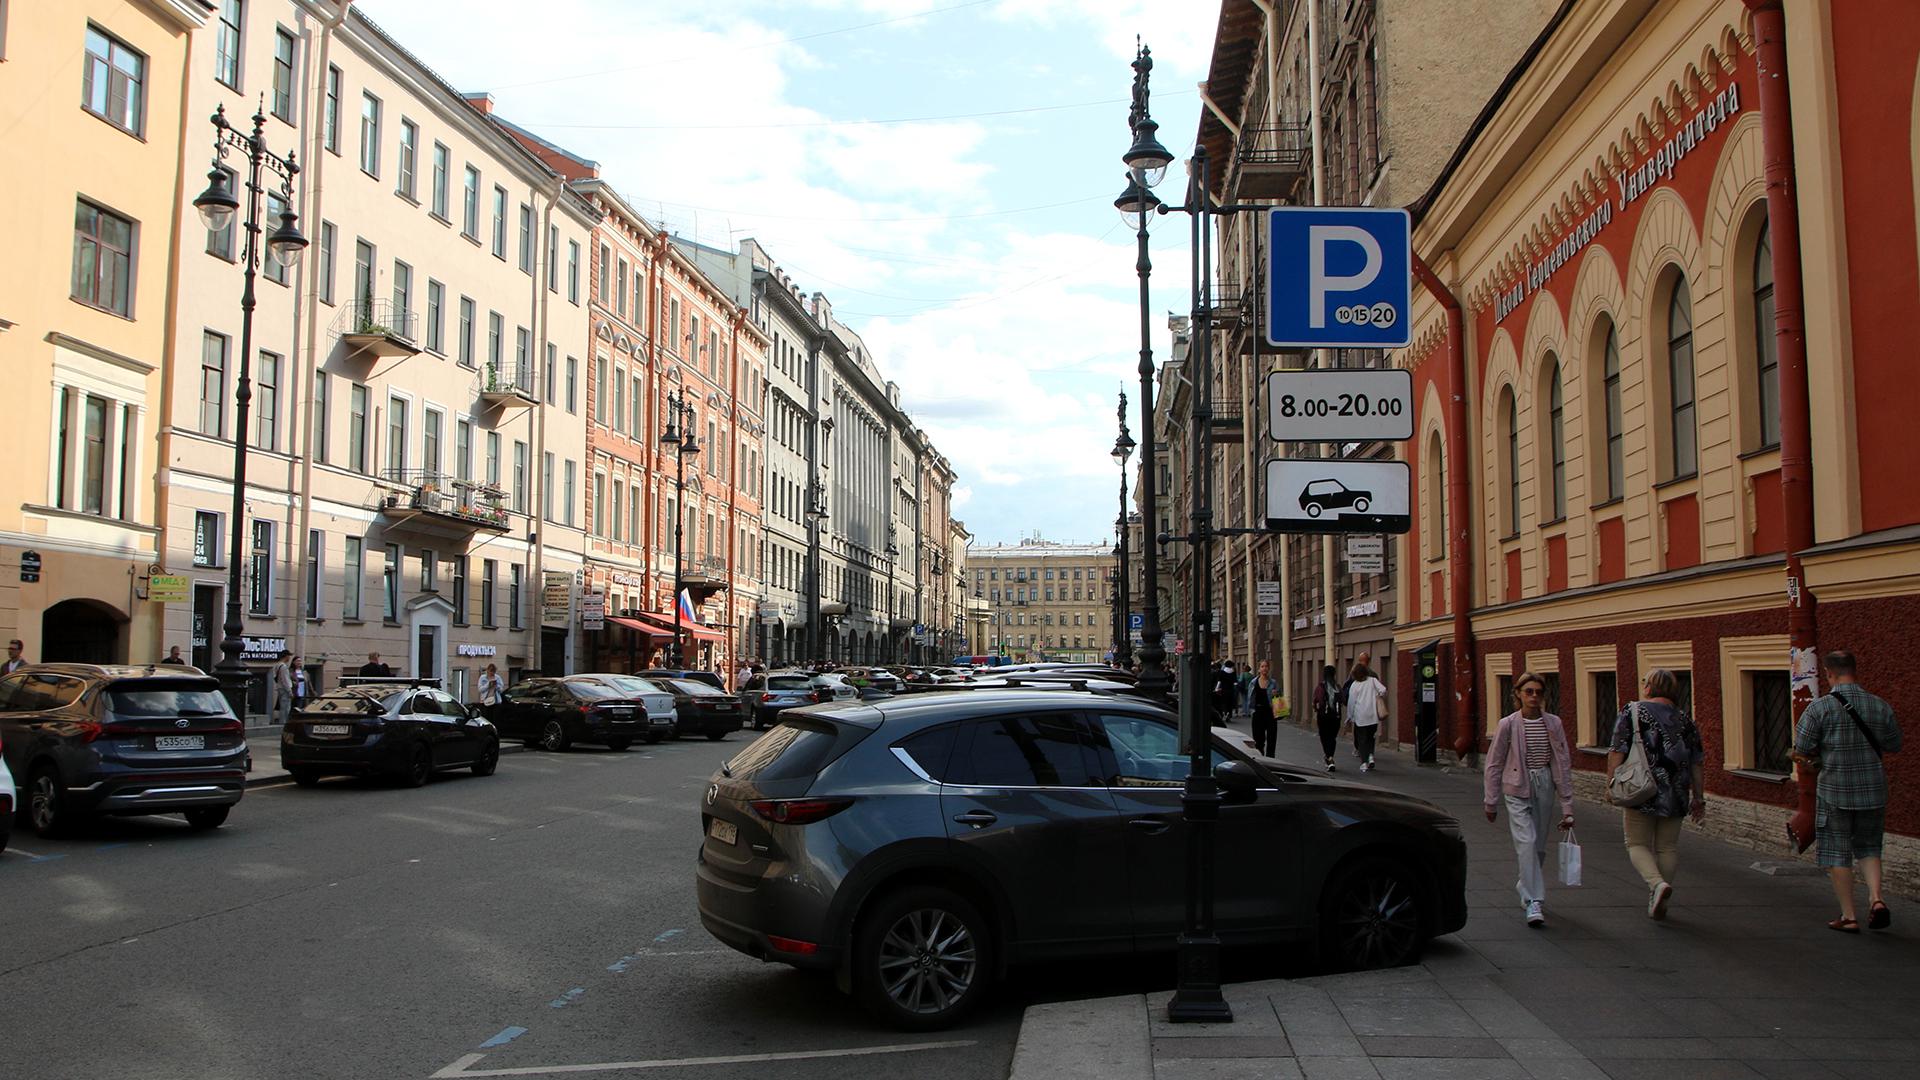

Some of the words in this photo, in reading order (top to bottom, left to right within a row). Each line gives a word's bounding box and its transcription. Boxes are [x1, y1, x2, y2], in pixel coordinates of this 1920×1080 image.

[1493, 281, 1525, 325] Школа
[1525, 199, 1613, 296] Герценовского
[1616, 81, 1740, 212] Университета
[1309, 225, 1383, 329] P
[1338, 310, 1350, 320] 10
[1354, 309, 1367, 322] 15
[1372, 308, 1393, 324] 20
[1281, 394, 1402, 418] 8.00-20.00
